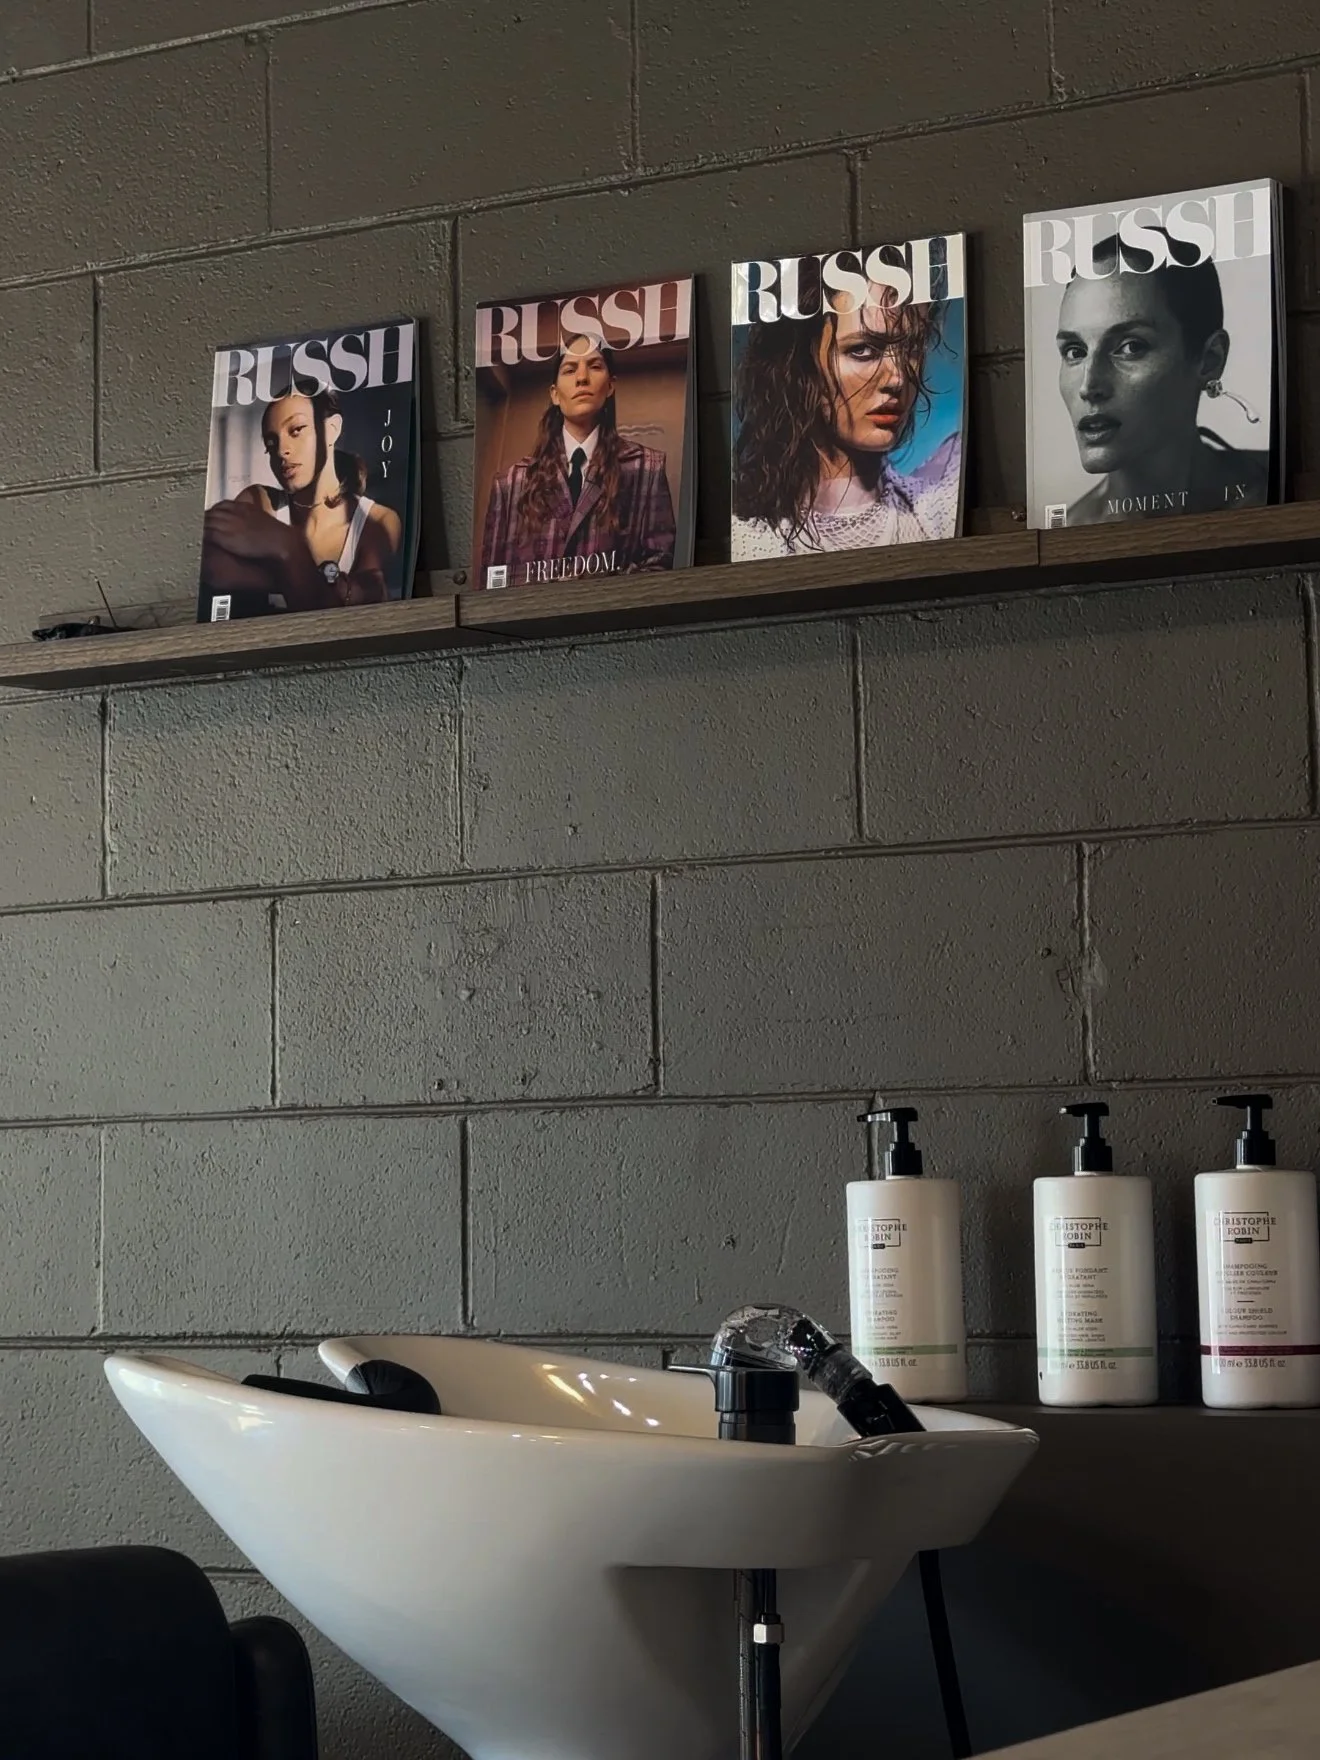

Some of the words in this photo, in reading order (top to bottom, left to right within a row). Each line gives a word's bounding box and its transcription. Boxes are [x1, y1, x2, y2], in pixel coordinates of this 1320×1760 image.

[732, 233, 963, 324] RUSSH
[1024, 187, 1270, 287] RUSSH
[476, 279, 692, 368] RUSSH
[212, 324, 413, 407] RUSSH
[1108, 491, 1188, 515] MOMENT
[1223, 484, 1246, 501] IN
[1214, 1217, 1277, 1226] CRISTOPHE
[1227, 1226, 1260, 1236] ROBIN
